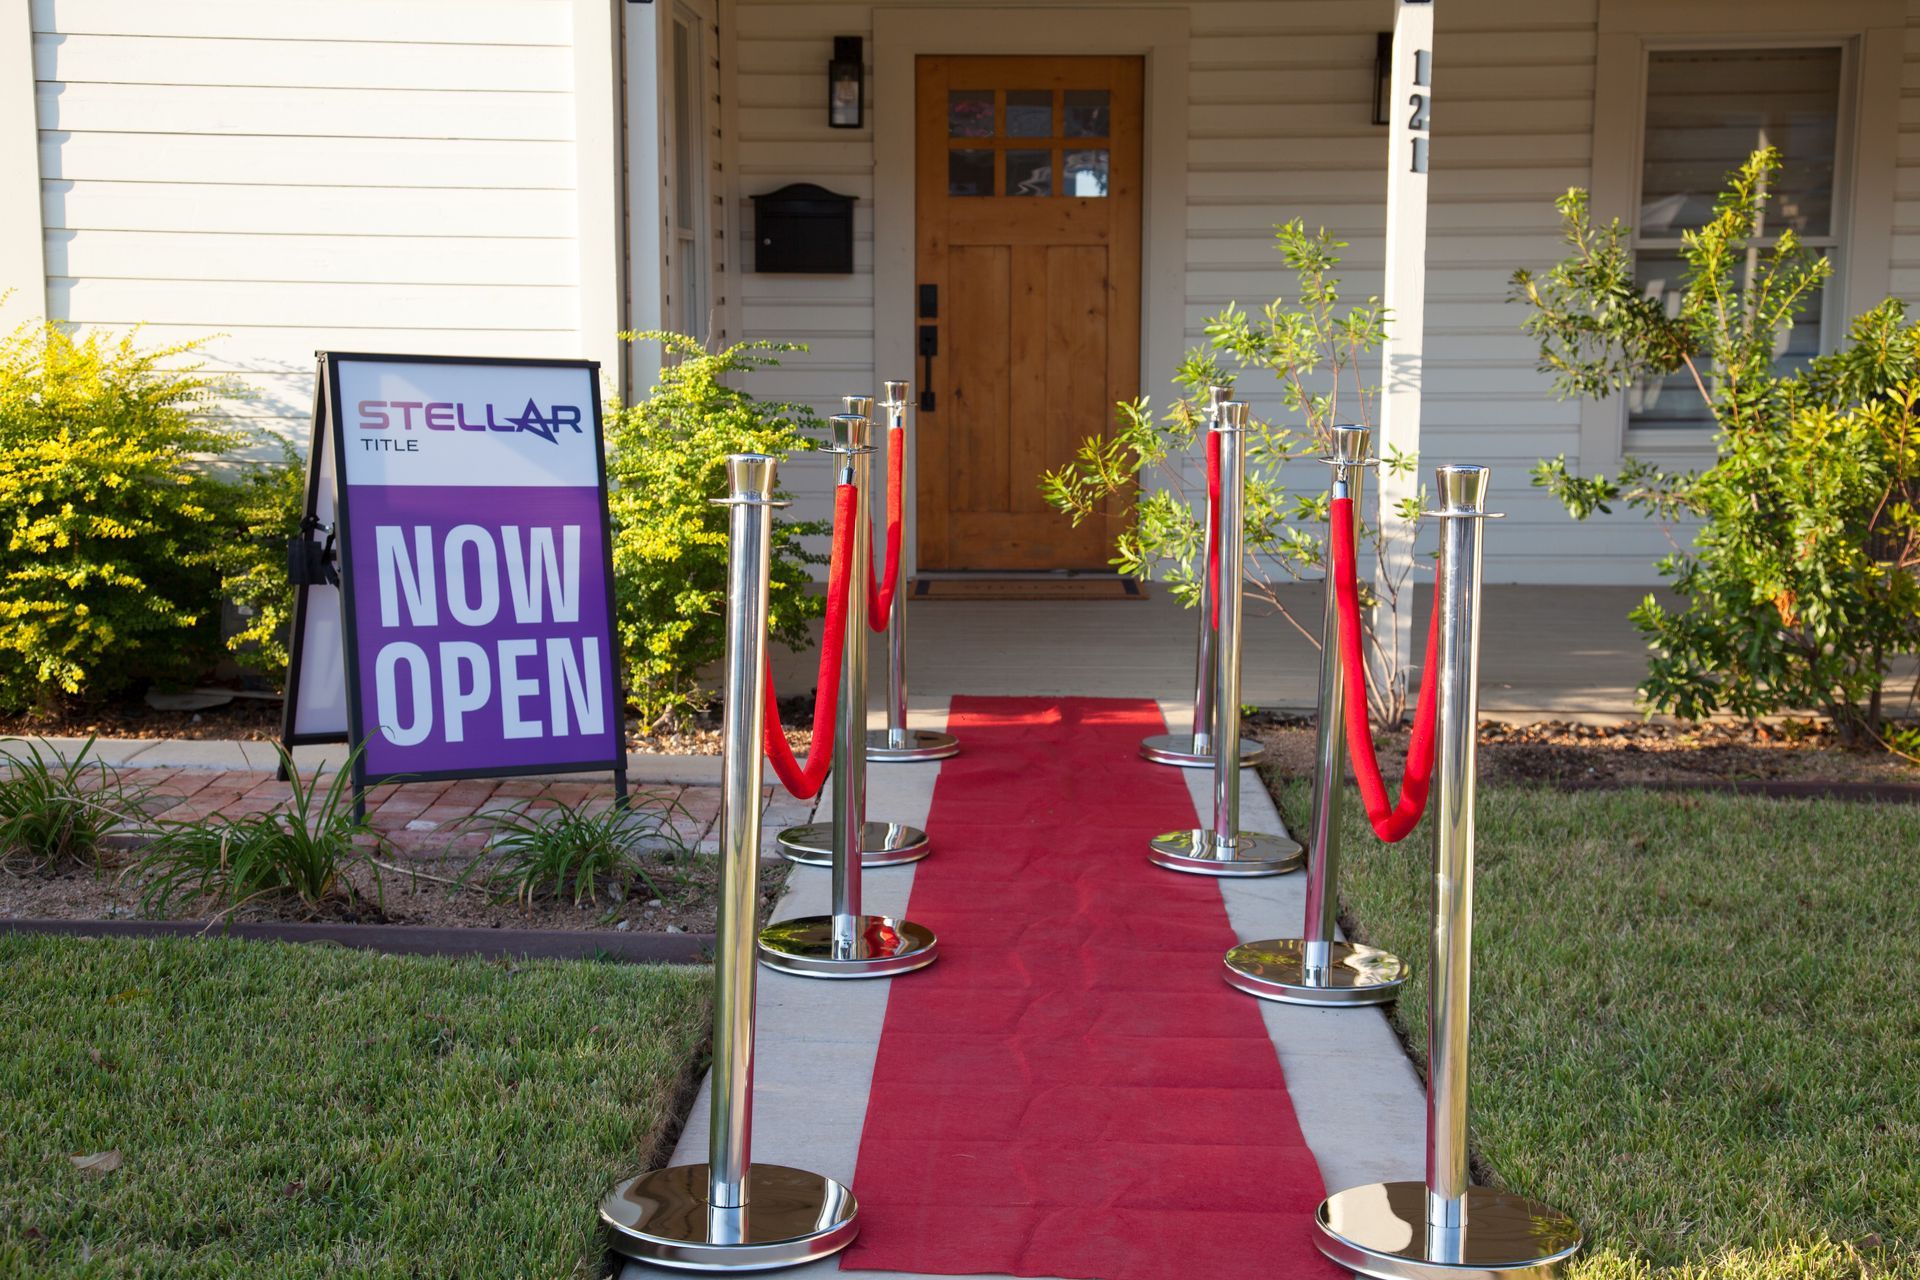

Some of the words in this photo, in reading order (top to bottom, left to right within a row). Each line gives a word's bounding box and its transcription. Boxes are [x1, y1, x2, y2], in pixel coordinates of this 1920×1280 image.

[1408, 49, 1428, 174] 121
[358, 397, 583, 445] STELLAR
[360, 438, 419, 452] TITLE
[375, 524, 581, 627] NOW
[375, 637, 605, 746] OPEN
